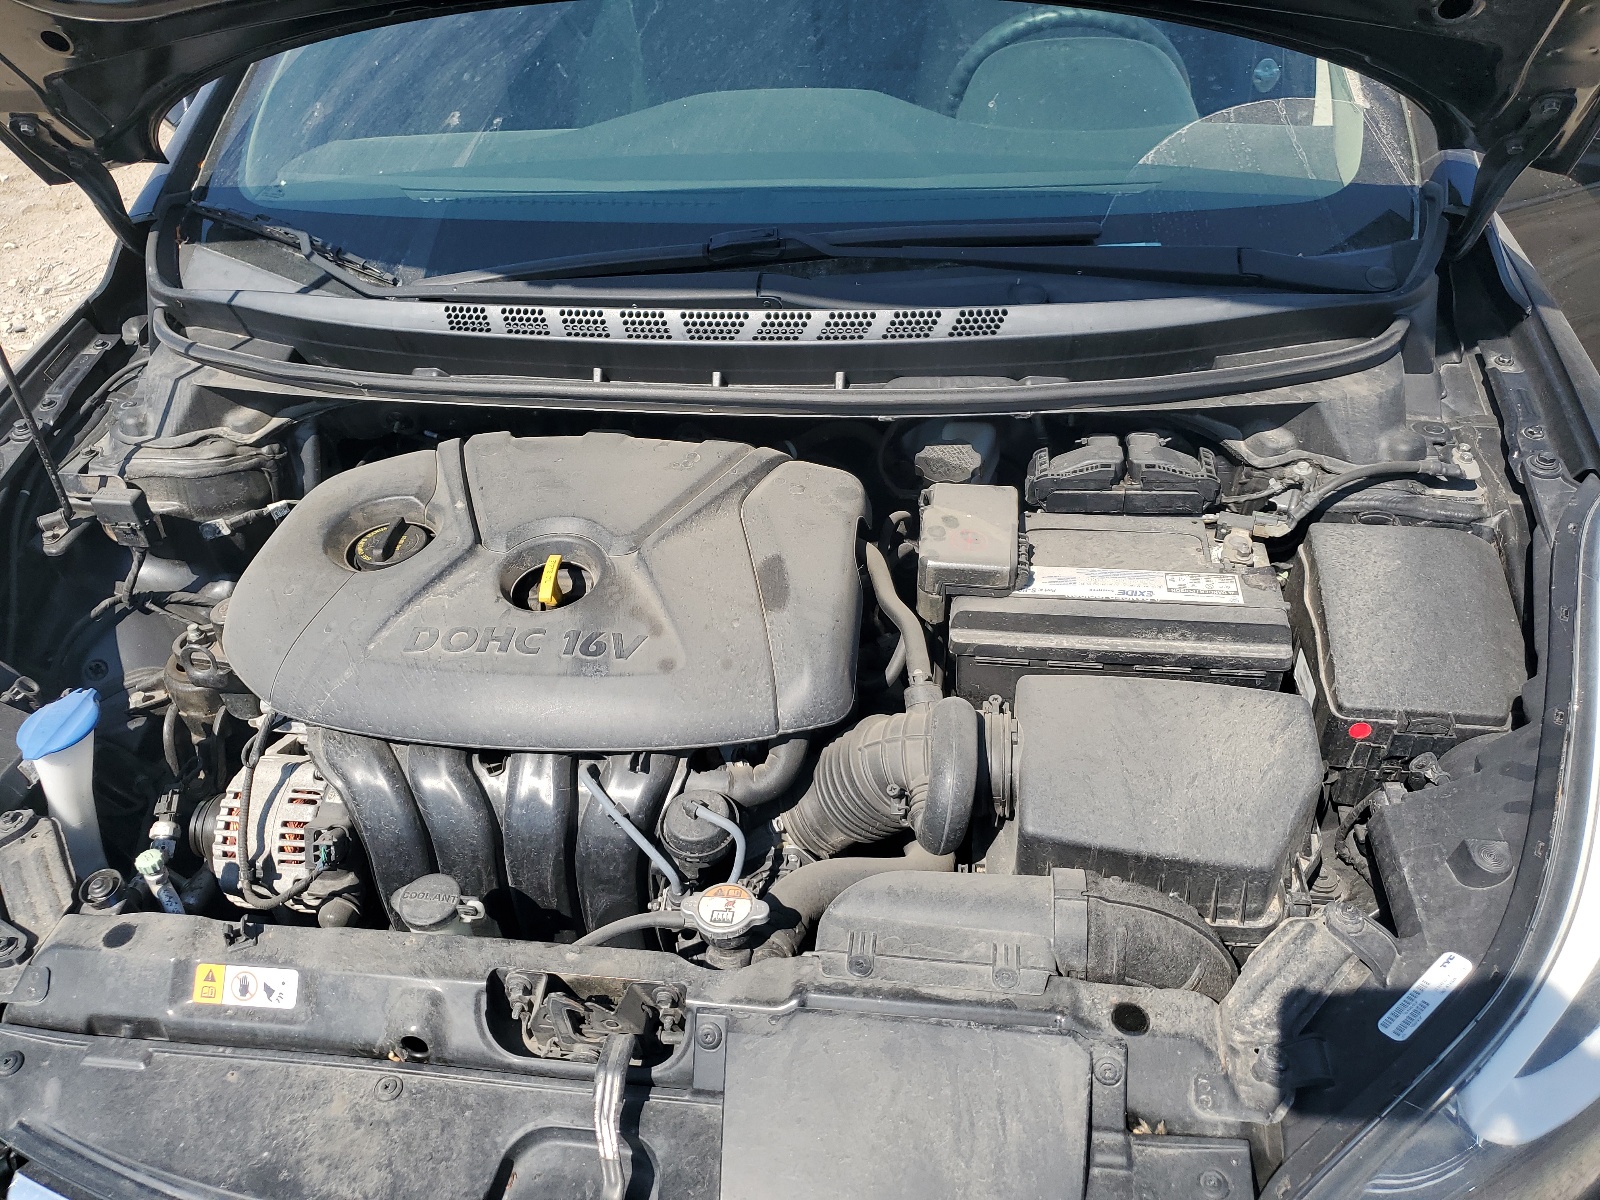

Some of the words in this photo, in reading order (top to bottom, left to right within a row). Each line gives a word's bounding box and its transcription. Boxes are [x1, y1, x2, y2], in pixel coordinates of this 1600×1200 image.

[1117, 589, 1155, 598] EXIDE
[403, 626, 547, 655] DOHC
[562, 629, 650, 660] 16V
[402, 891, 459, 904] COOLANT
